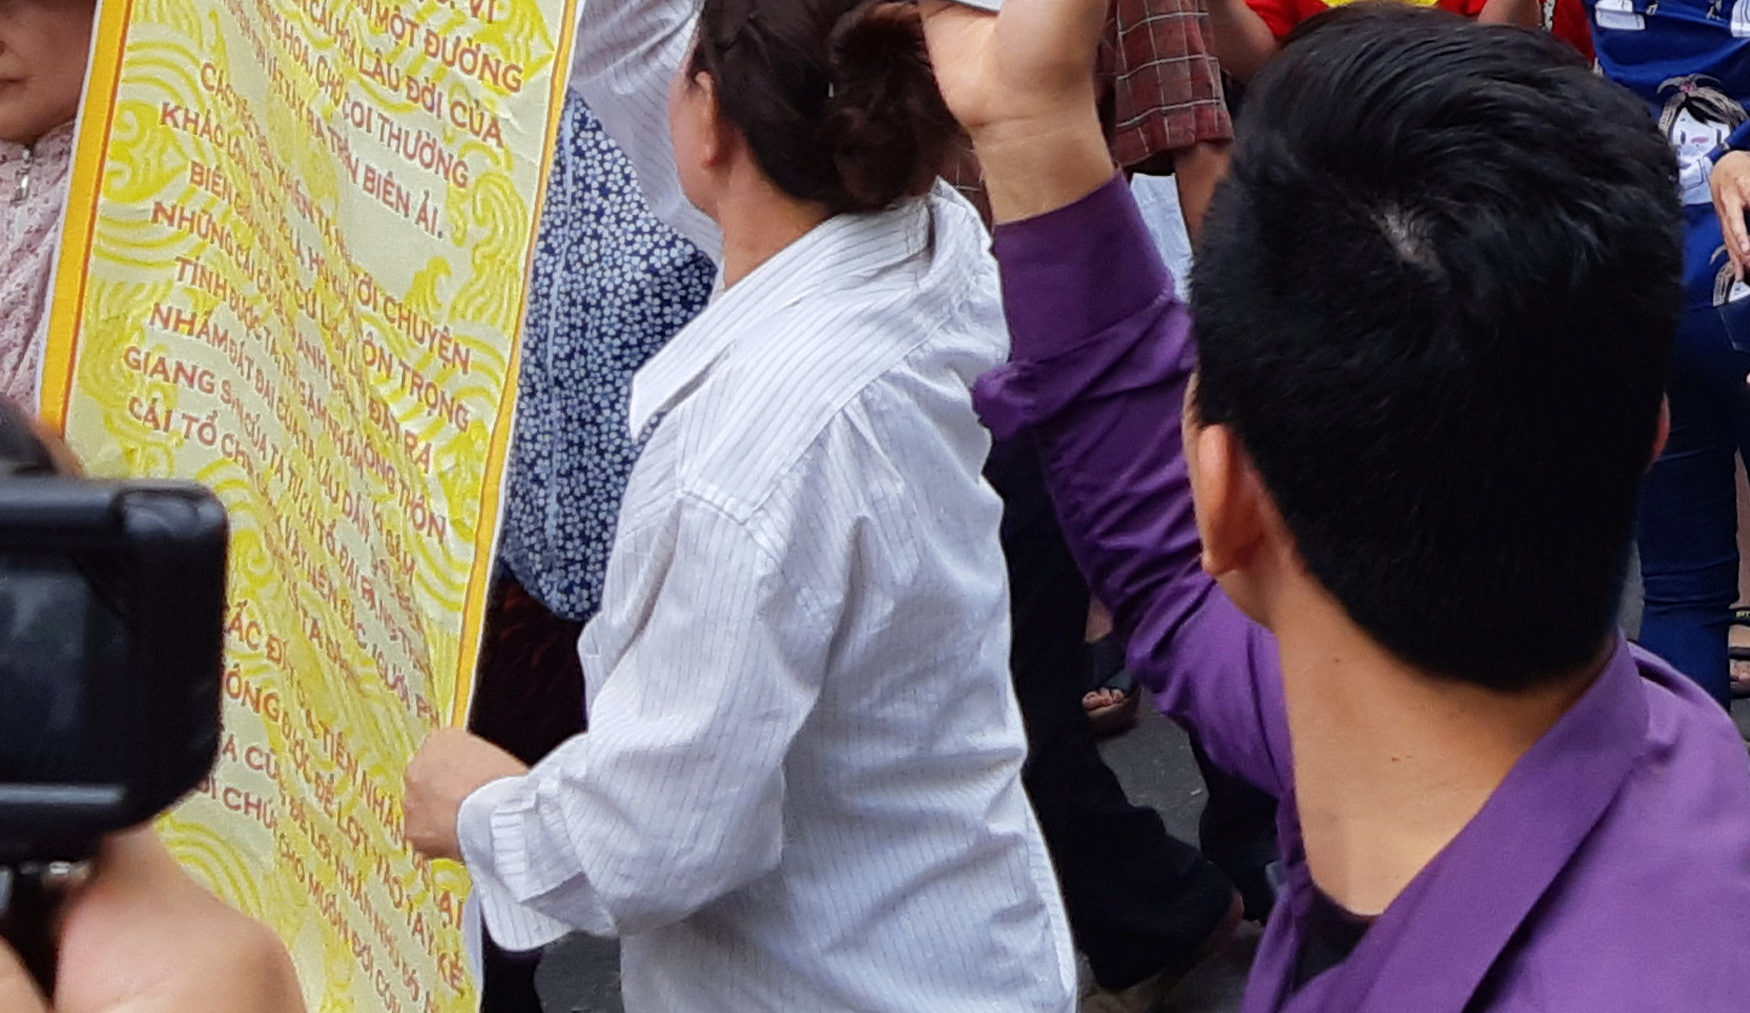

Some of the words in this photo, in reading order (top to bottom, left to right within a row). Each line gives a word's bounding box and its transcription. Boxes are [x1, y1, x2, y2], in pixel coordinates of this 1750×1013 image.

[374, 4, 421, 52] MỘT
[424, 28, 524, 93] ĐƯỜNG
[359, 48, 401, 94] LÂU
[406, 74, 444, 121] ĐỜI
[449, 98, 505, 148] CỦA
[377, 111, 471, 189] THƯỜNG
[362, 163, 411, 218] BIÊN
[415, 189, 445, 239] ẢI.
[159, 102, 225, 148] KHÁC
[398, 361, 470, 433] TRỌNG
[175, 255, 228, 302] TÍNH
[189, 160, 232, 206] BIÊN
[404, 430, 434, 474] RA
[383, 300, 472, 376] CHUYỆN
[123, 345, 217, 397] GIANG
[151, 200, 234, 257] NHỮNG
[399, 481, 448, 546] THÔN
[127, 396, 174, 435] CÁI
[181, 406, 218, 448] TỔ
